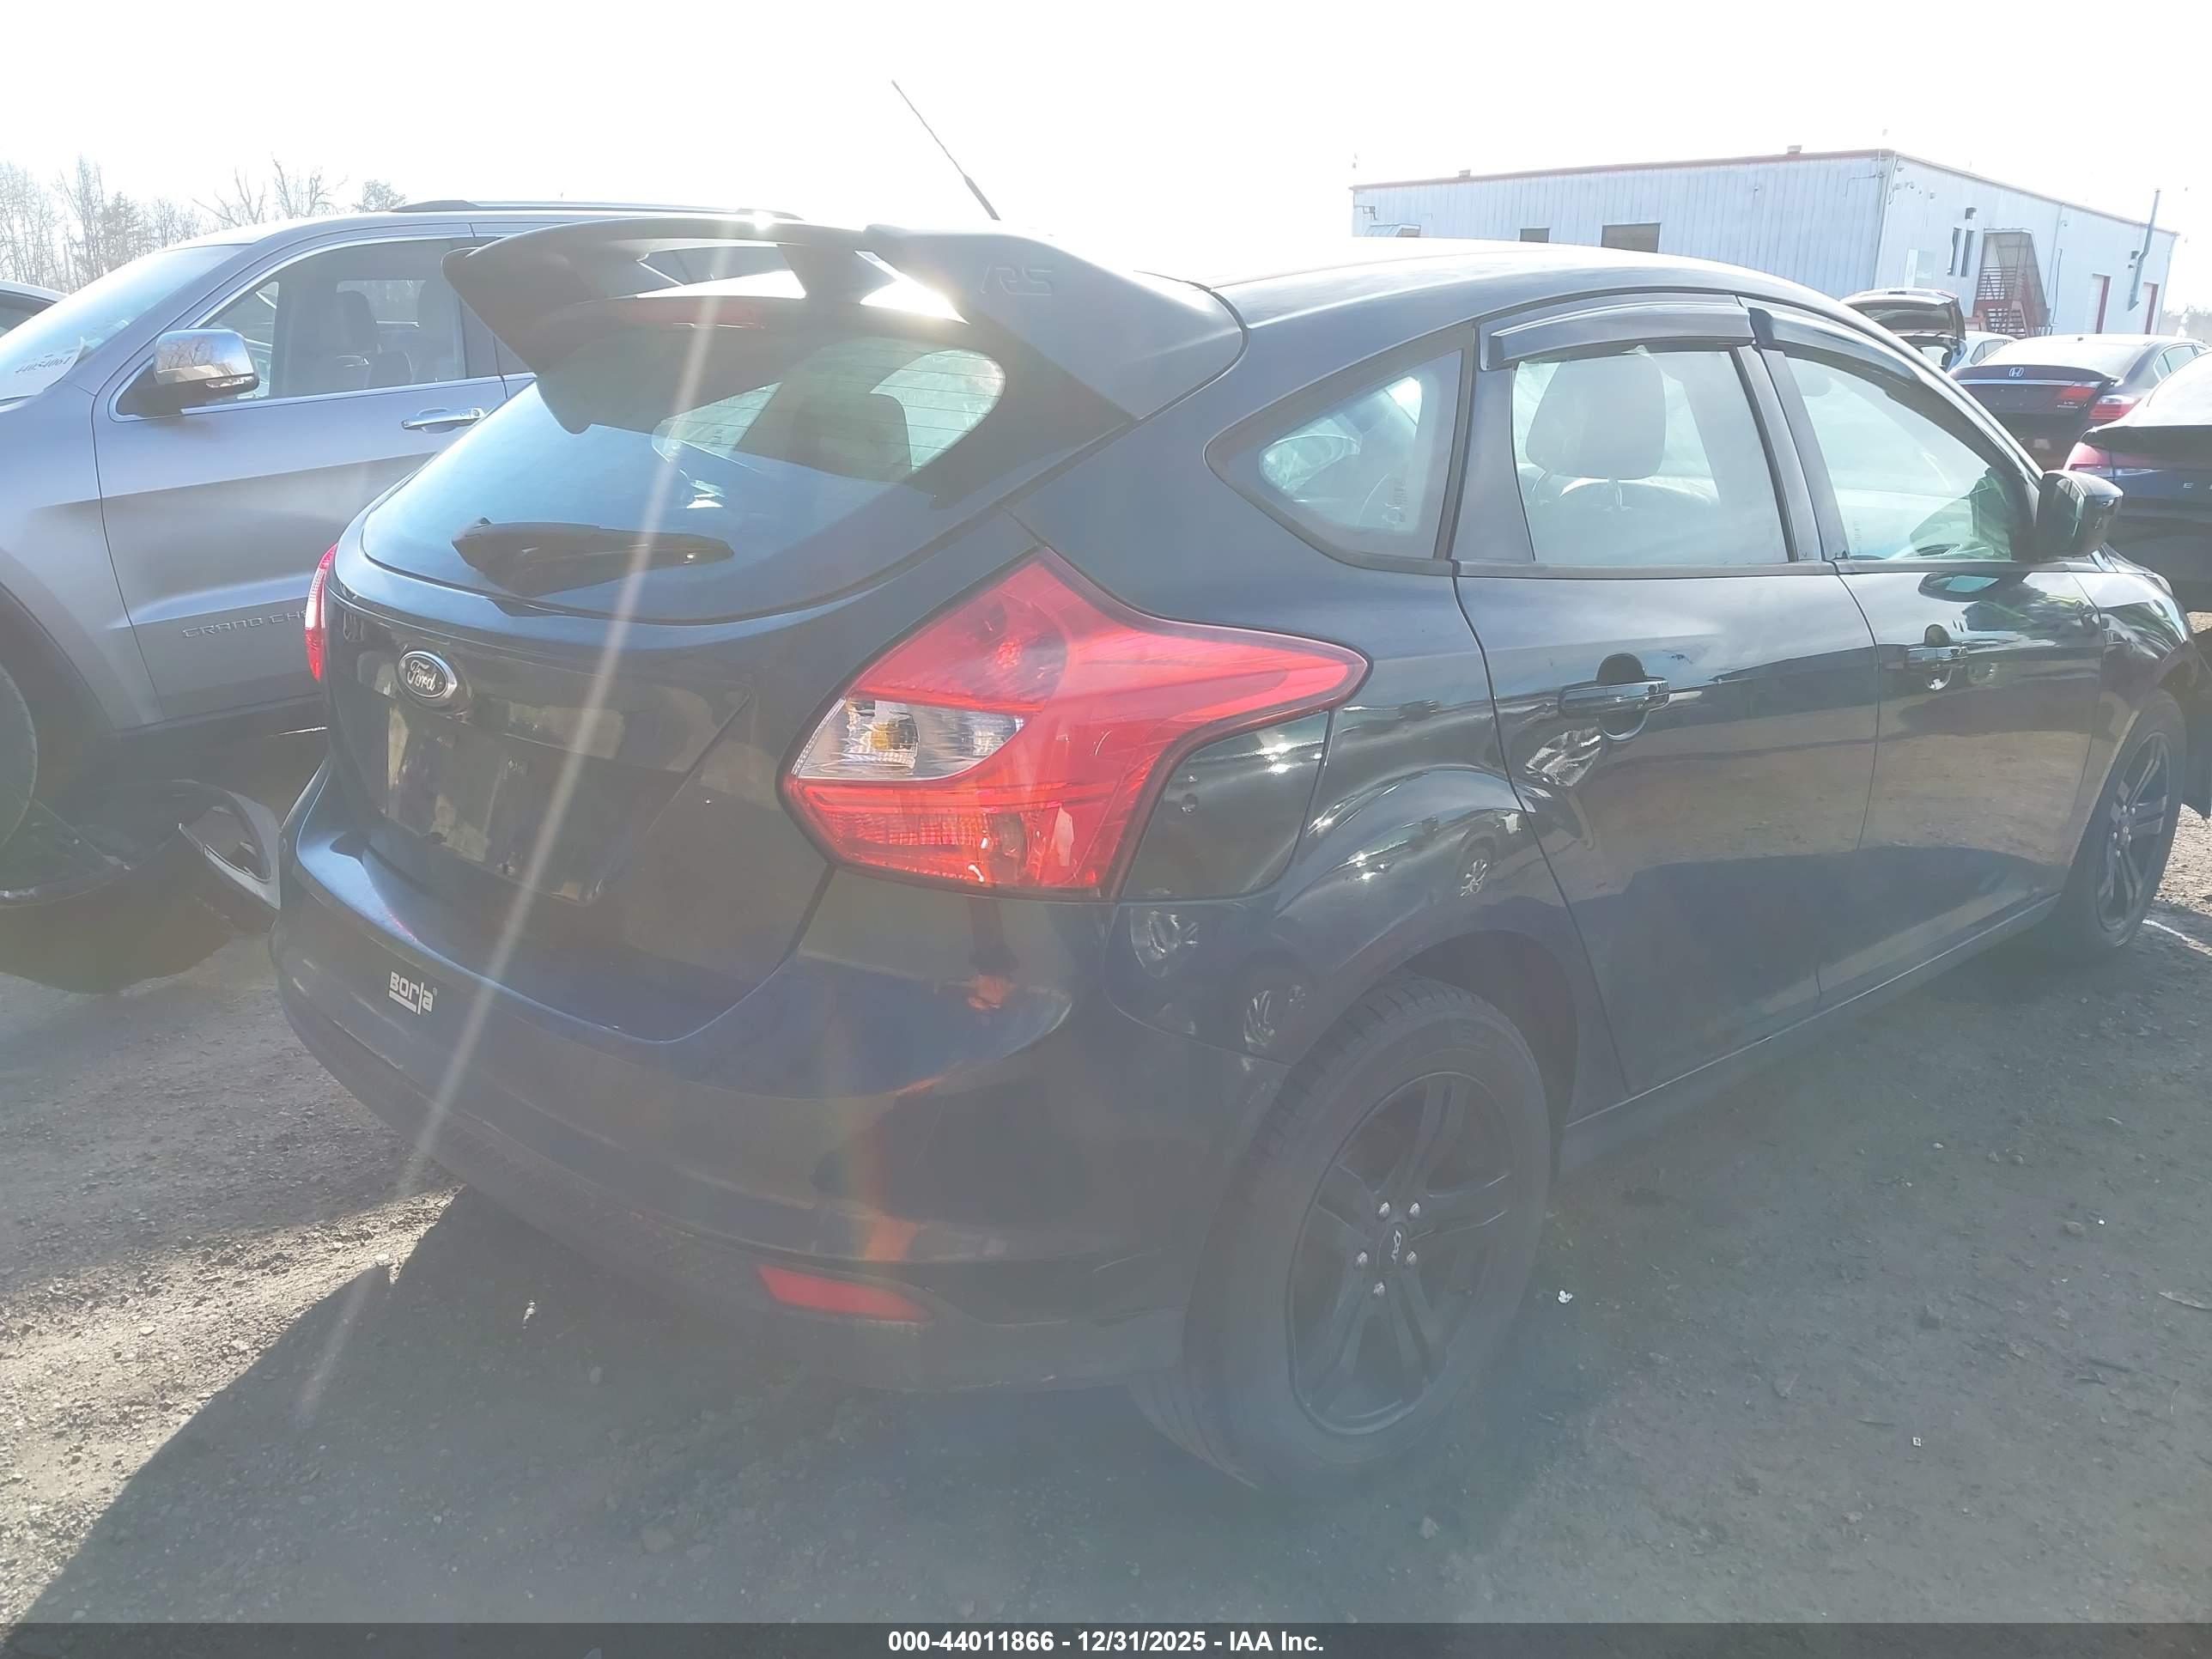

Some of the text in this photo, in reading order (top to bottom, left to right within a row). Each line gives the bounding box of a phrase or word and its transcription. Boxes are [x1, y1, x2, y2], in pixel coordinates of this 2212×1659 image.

[981, 262, 1055, 297] RS
[181, 617, 263, 638] GRAND
[407, 659, 438, 691] Ford
